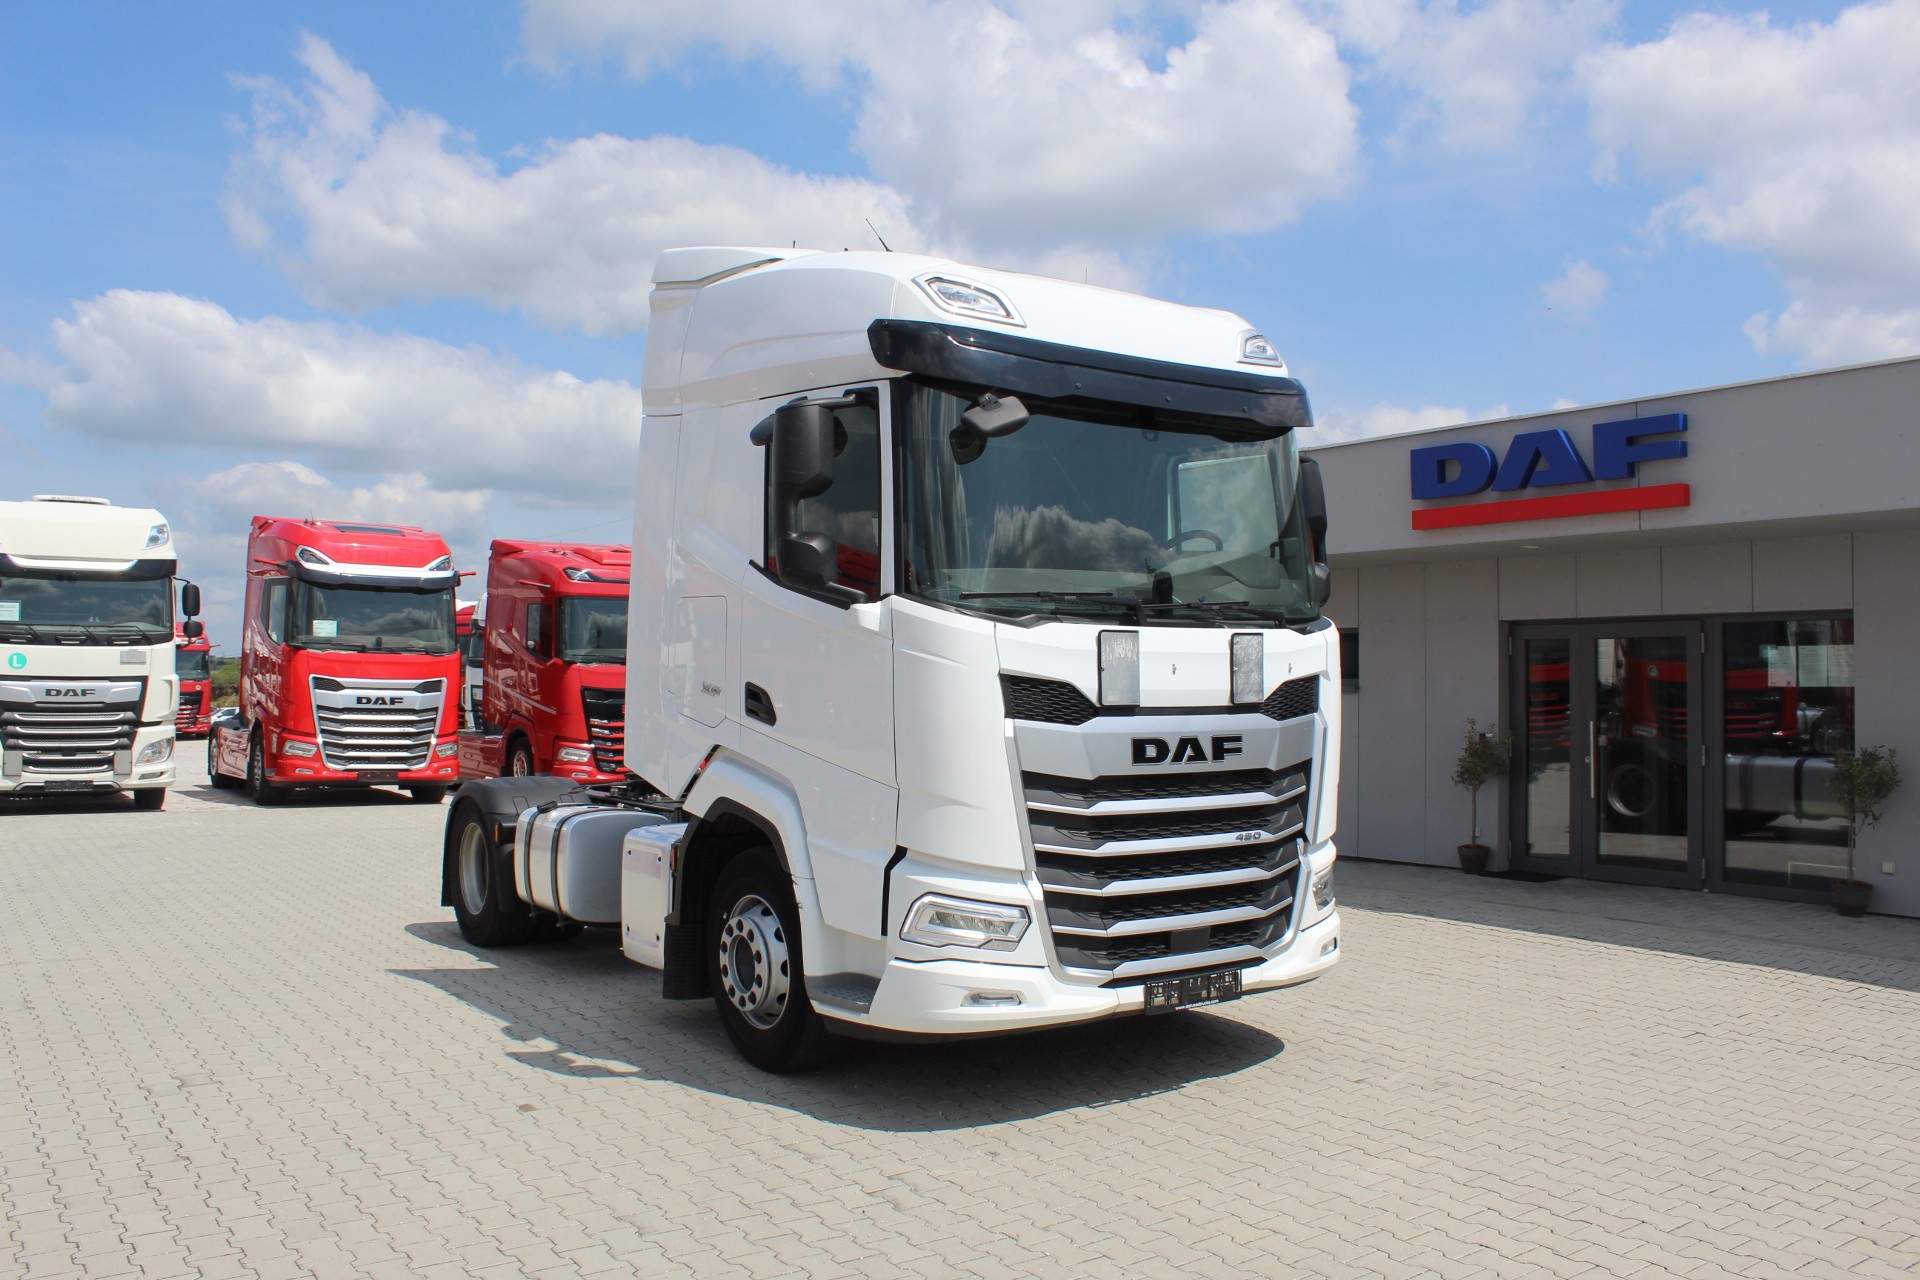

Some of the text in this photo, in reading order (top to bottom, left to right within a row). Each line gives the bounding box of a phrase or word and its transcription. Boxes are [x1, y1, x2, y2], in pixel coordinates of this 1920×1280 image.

[1410, 413, 1688, 500] DAF
[12, 654, 23, 668] L
[45, 688, 96, 697] DAF
[356, 696, 404, 706] DAF
[1131, 734, 1243, 766] DAF
